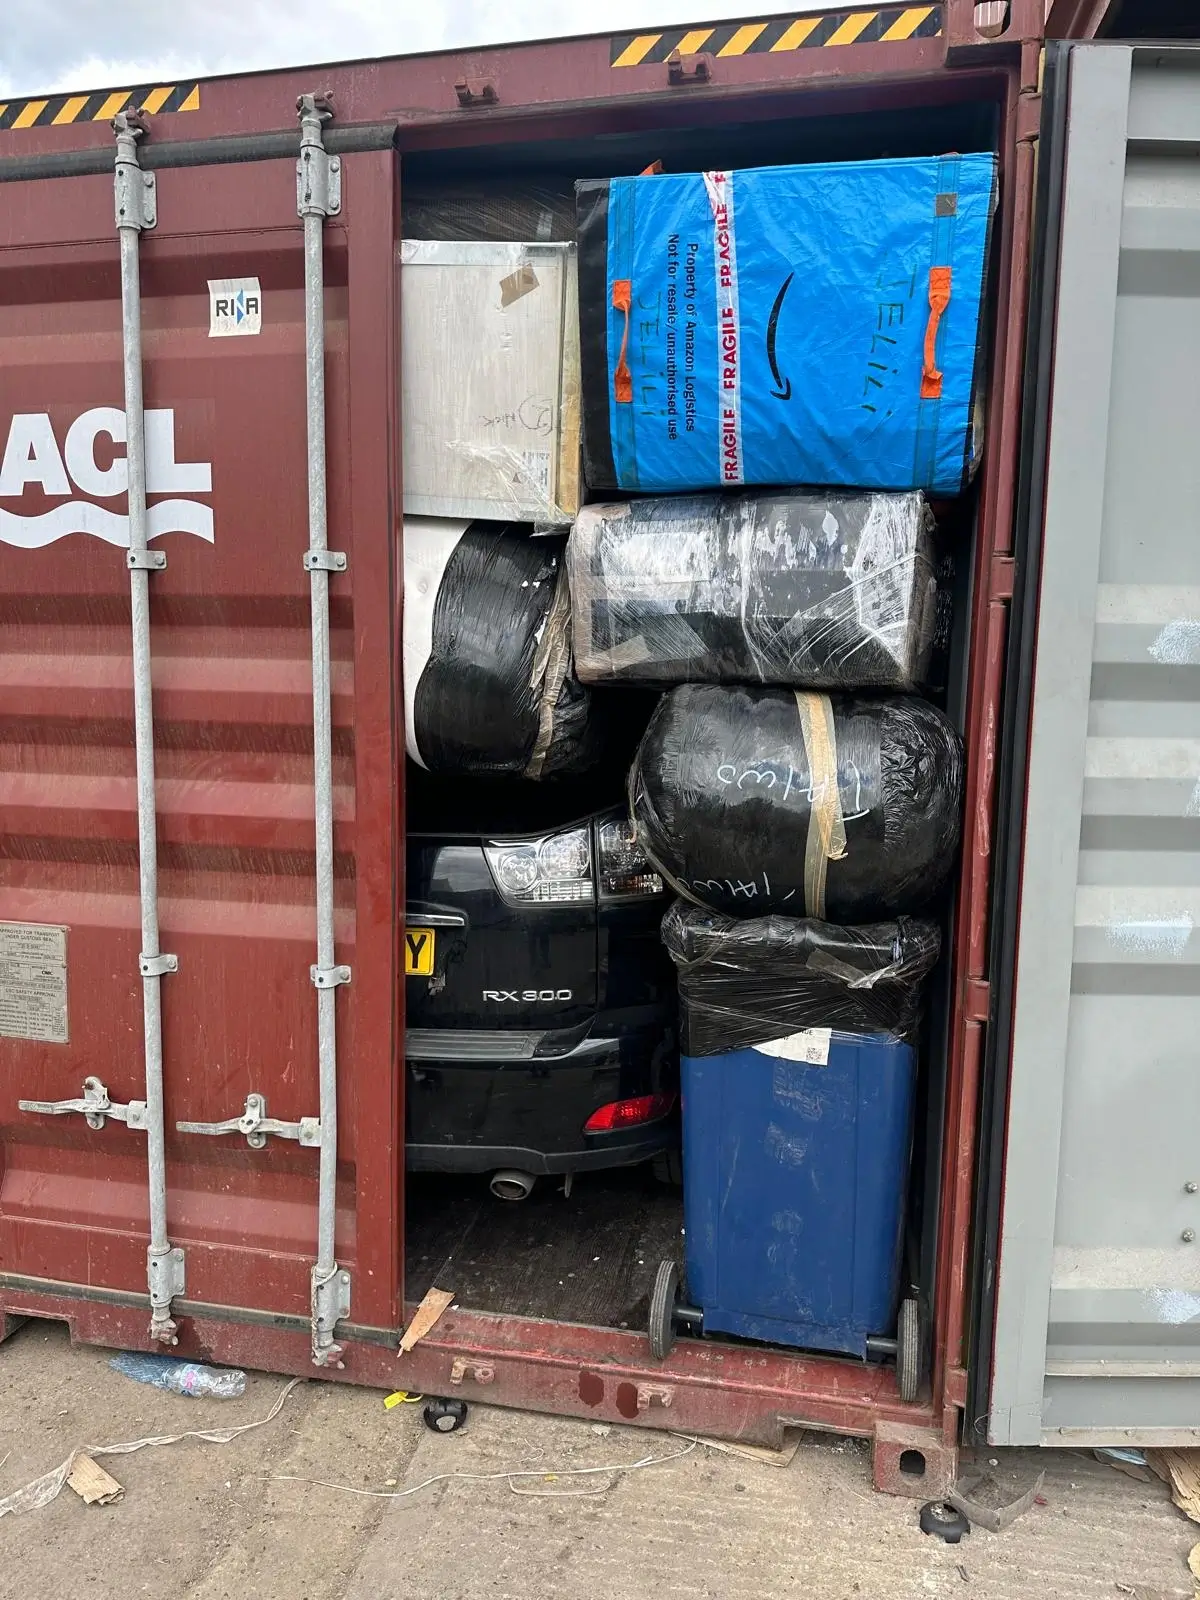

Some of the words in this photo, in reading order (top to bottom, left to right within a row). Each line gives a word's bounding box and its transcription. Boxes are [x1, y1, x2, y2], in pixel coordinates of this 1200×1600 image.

[667, 233, 679, 258] Not
[667, 260, 679, 279] for
[684, 243, 699, 299] Property
[716, 203, 732, 287] FRAGILE
[216, 288, 259, 325] RINA
[686, 304, 698, 316] of
[665, 284, 679, 415] resale/unauthorised
[685, 319, 697, 372] Amazon
[722, 307, 737, 389] FRAGILE
[668, 419, 678, 440] use
[683, 376, 697, 432] Logistics
[0, 407, 212, 497] ACL
[723, 409, 738, 480] FRAGILE
[482, 990, 520, 1002] RX
[522, 989, 573, 1001] 300
